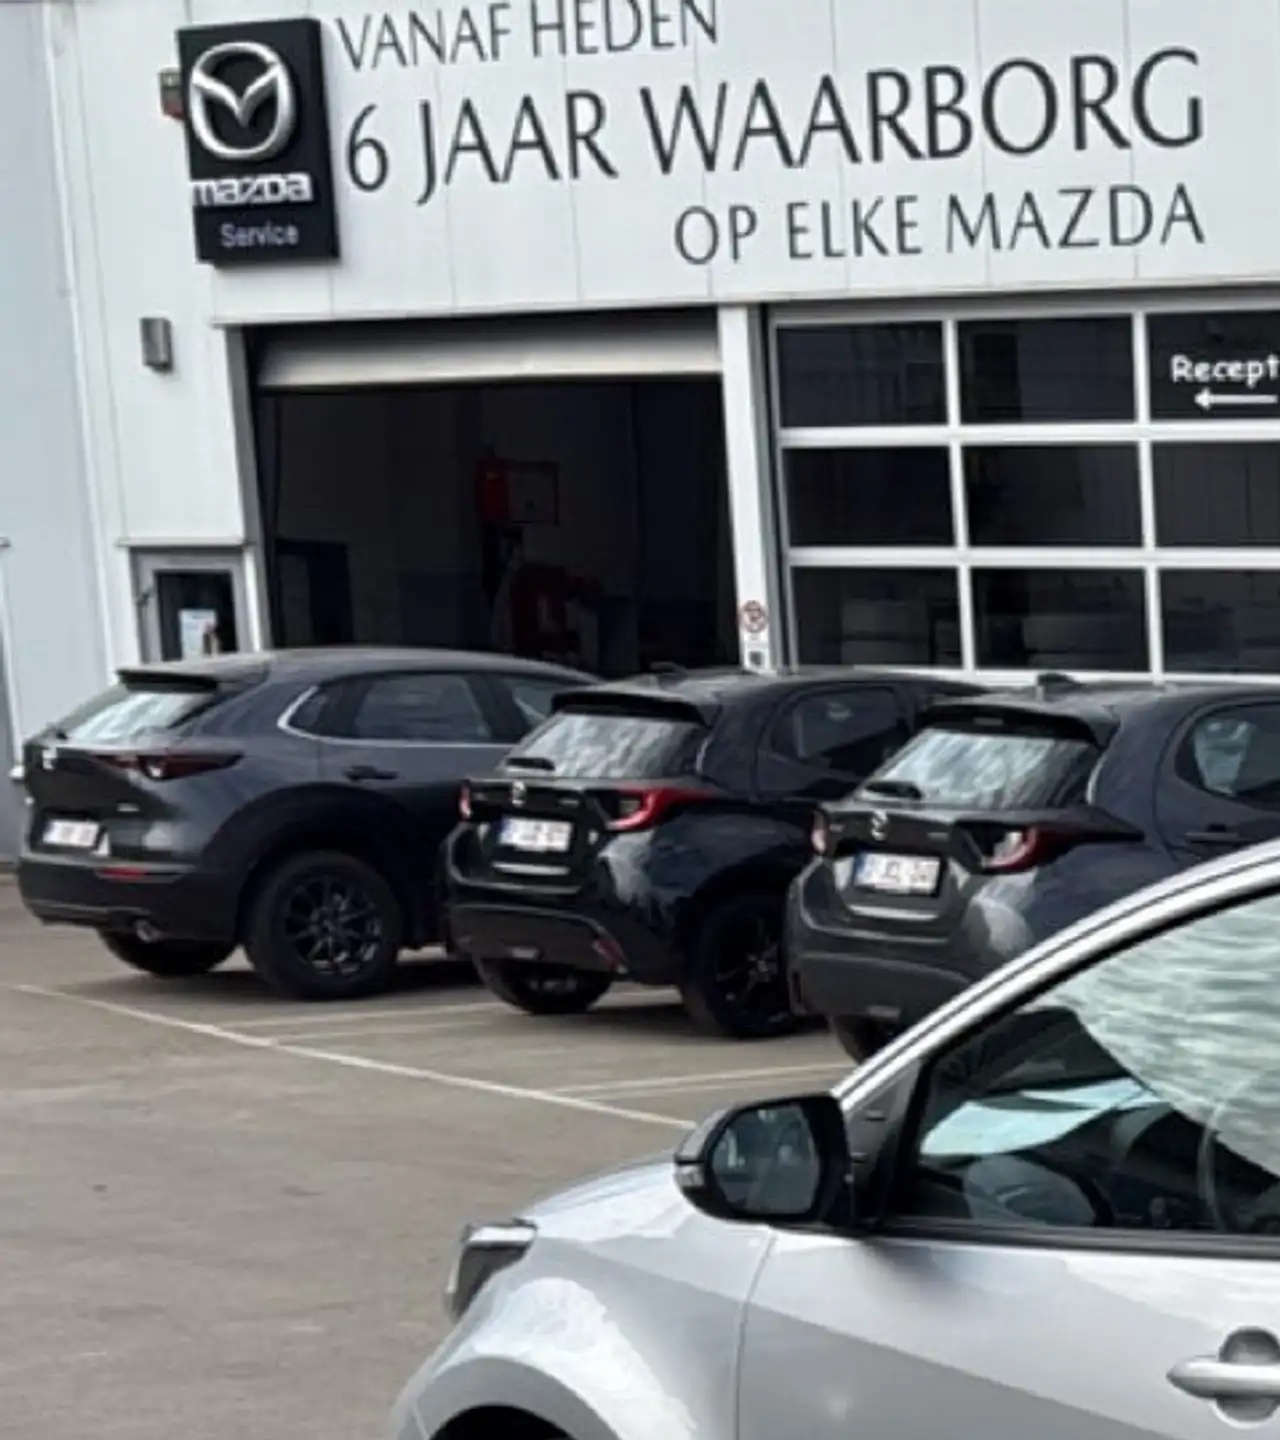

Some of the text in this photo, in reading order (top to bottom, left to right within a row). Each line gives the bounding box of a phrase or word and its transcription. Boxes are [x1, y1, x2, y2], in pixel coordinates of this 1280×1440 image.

[335, 0, 718, 72] VANAF HEDEN
[347, 48, 1204, 207] 6 JAAR WAARBORG
[190, 171, 313, 206] mazda
[674, 182, 1206, 266] OP ELKE MAZDA
[219, 221, 299, 250] Service
